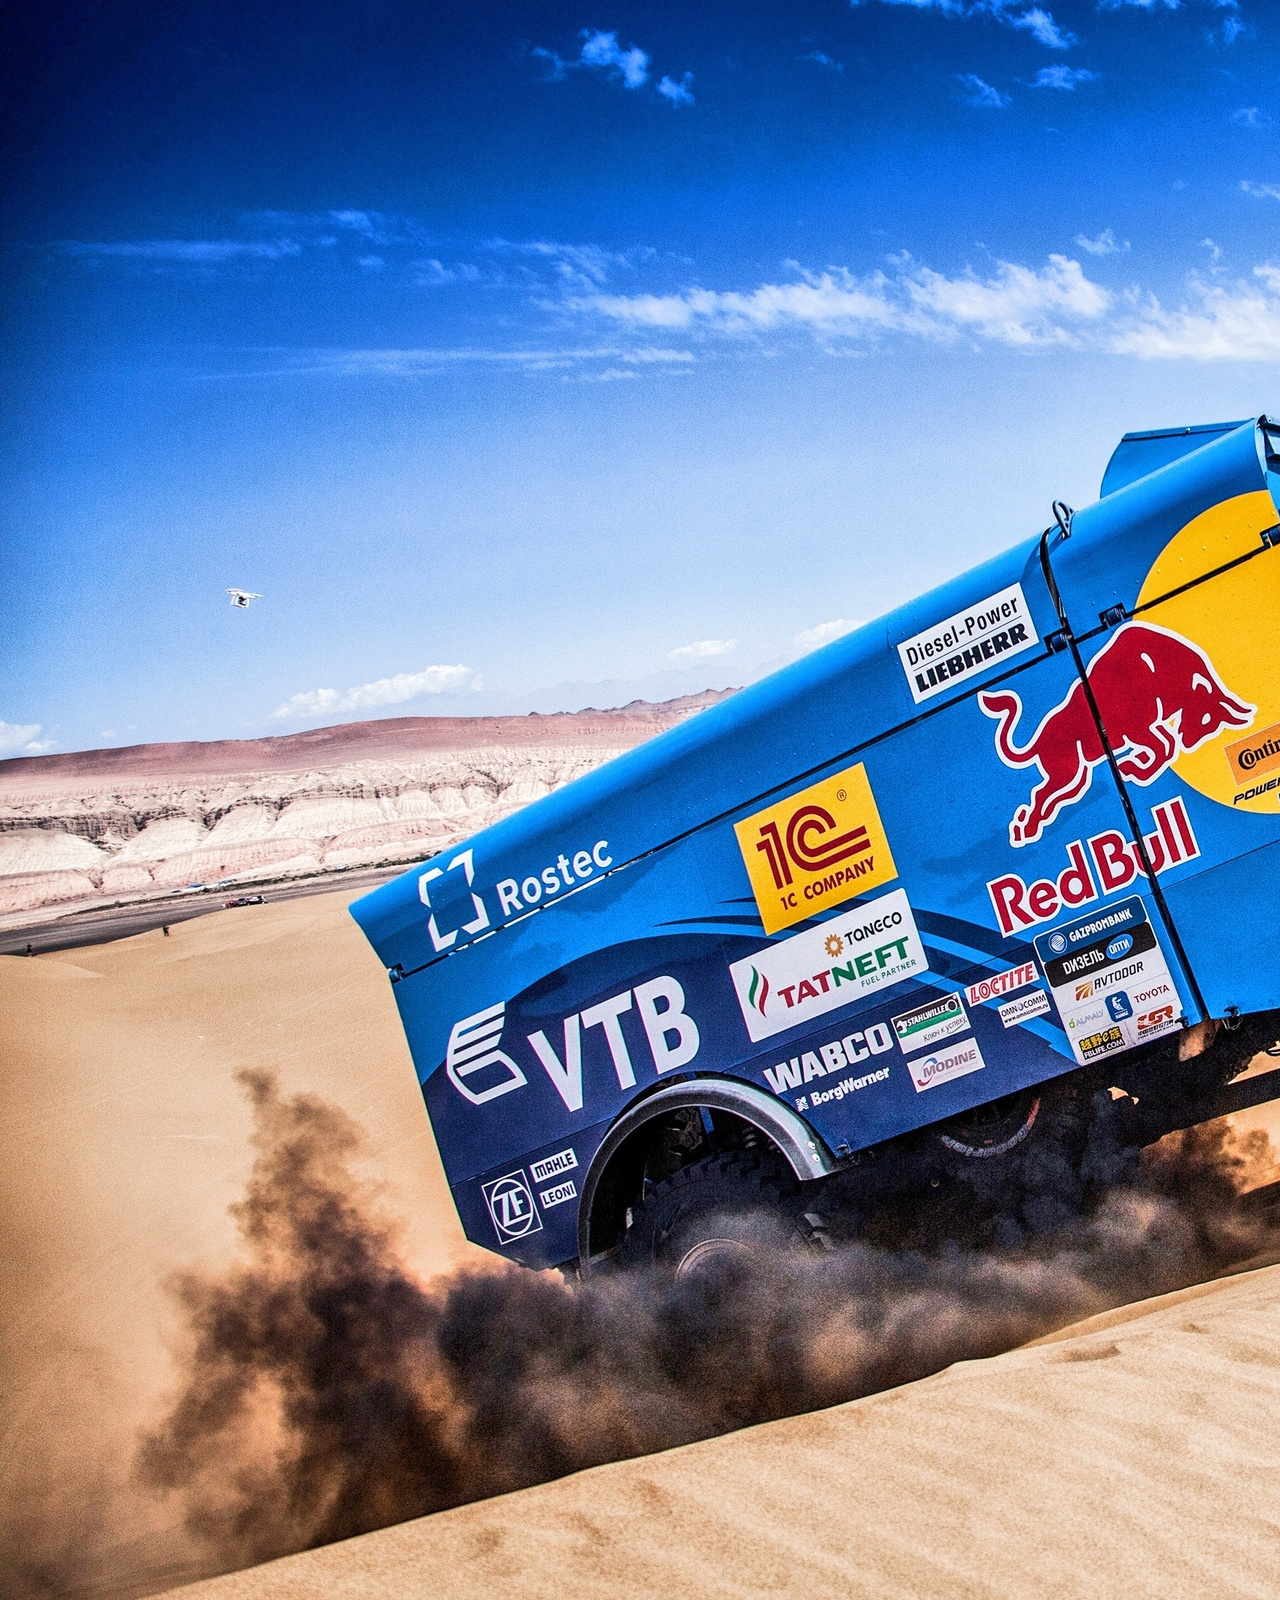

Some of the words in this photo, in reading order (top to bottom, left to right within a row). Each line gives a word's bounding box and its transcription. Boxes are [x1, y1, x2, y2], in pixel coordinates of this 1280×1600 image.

[905, 597, 1018, 666] Diesel-Power
[914, 622, 1030, 693] LIEBHERR
[496, 839, 613, 917] Rostec
[780, 892, 799, 911] 1C
[803, 856, 876, 900] COMPANY
[989, 843, 1095, 934] Red
[1090, 799, 1199, 891] Bull
[844, 911, 902, 946] TANECO
[1068, 908, 1134, 943] GAZPROMBANK
[1109, 938, 1130, 955] ОПТИ
[777, 936, 909, 1008] TATNEFT
[860, 974, 882, 988] FUEL
[881, 958, 917, 981] PARTNER
[970, 963, 1034, 1005] LOCTITE
[1094, 961, 1145, 990] AVTODOR
[1133, 984, 1171, 1004] TOYOTA
[907, 1004, 947, 1027] STAHLWILLE
[1075, 1009, 1105, 1027] ALMALY
[527, 975, 700, 1112] VTB
[763, 1022, 894, 1095] WABCO
[1083, 1038, 1125, 1059] FBLIFE.COM
[922, 1049, 977, 1078] MODINE
[810, 1066, 891, 1108] BorgWarner
[534, 1152, 575, 1179] MAHLE
[493, 1186, 532, 1228] ZF
[542, 1183, 575, 1206] LEONI
